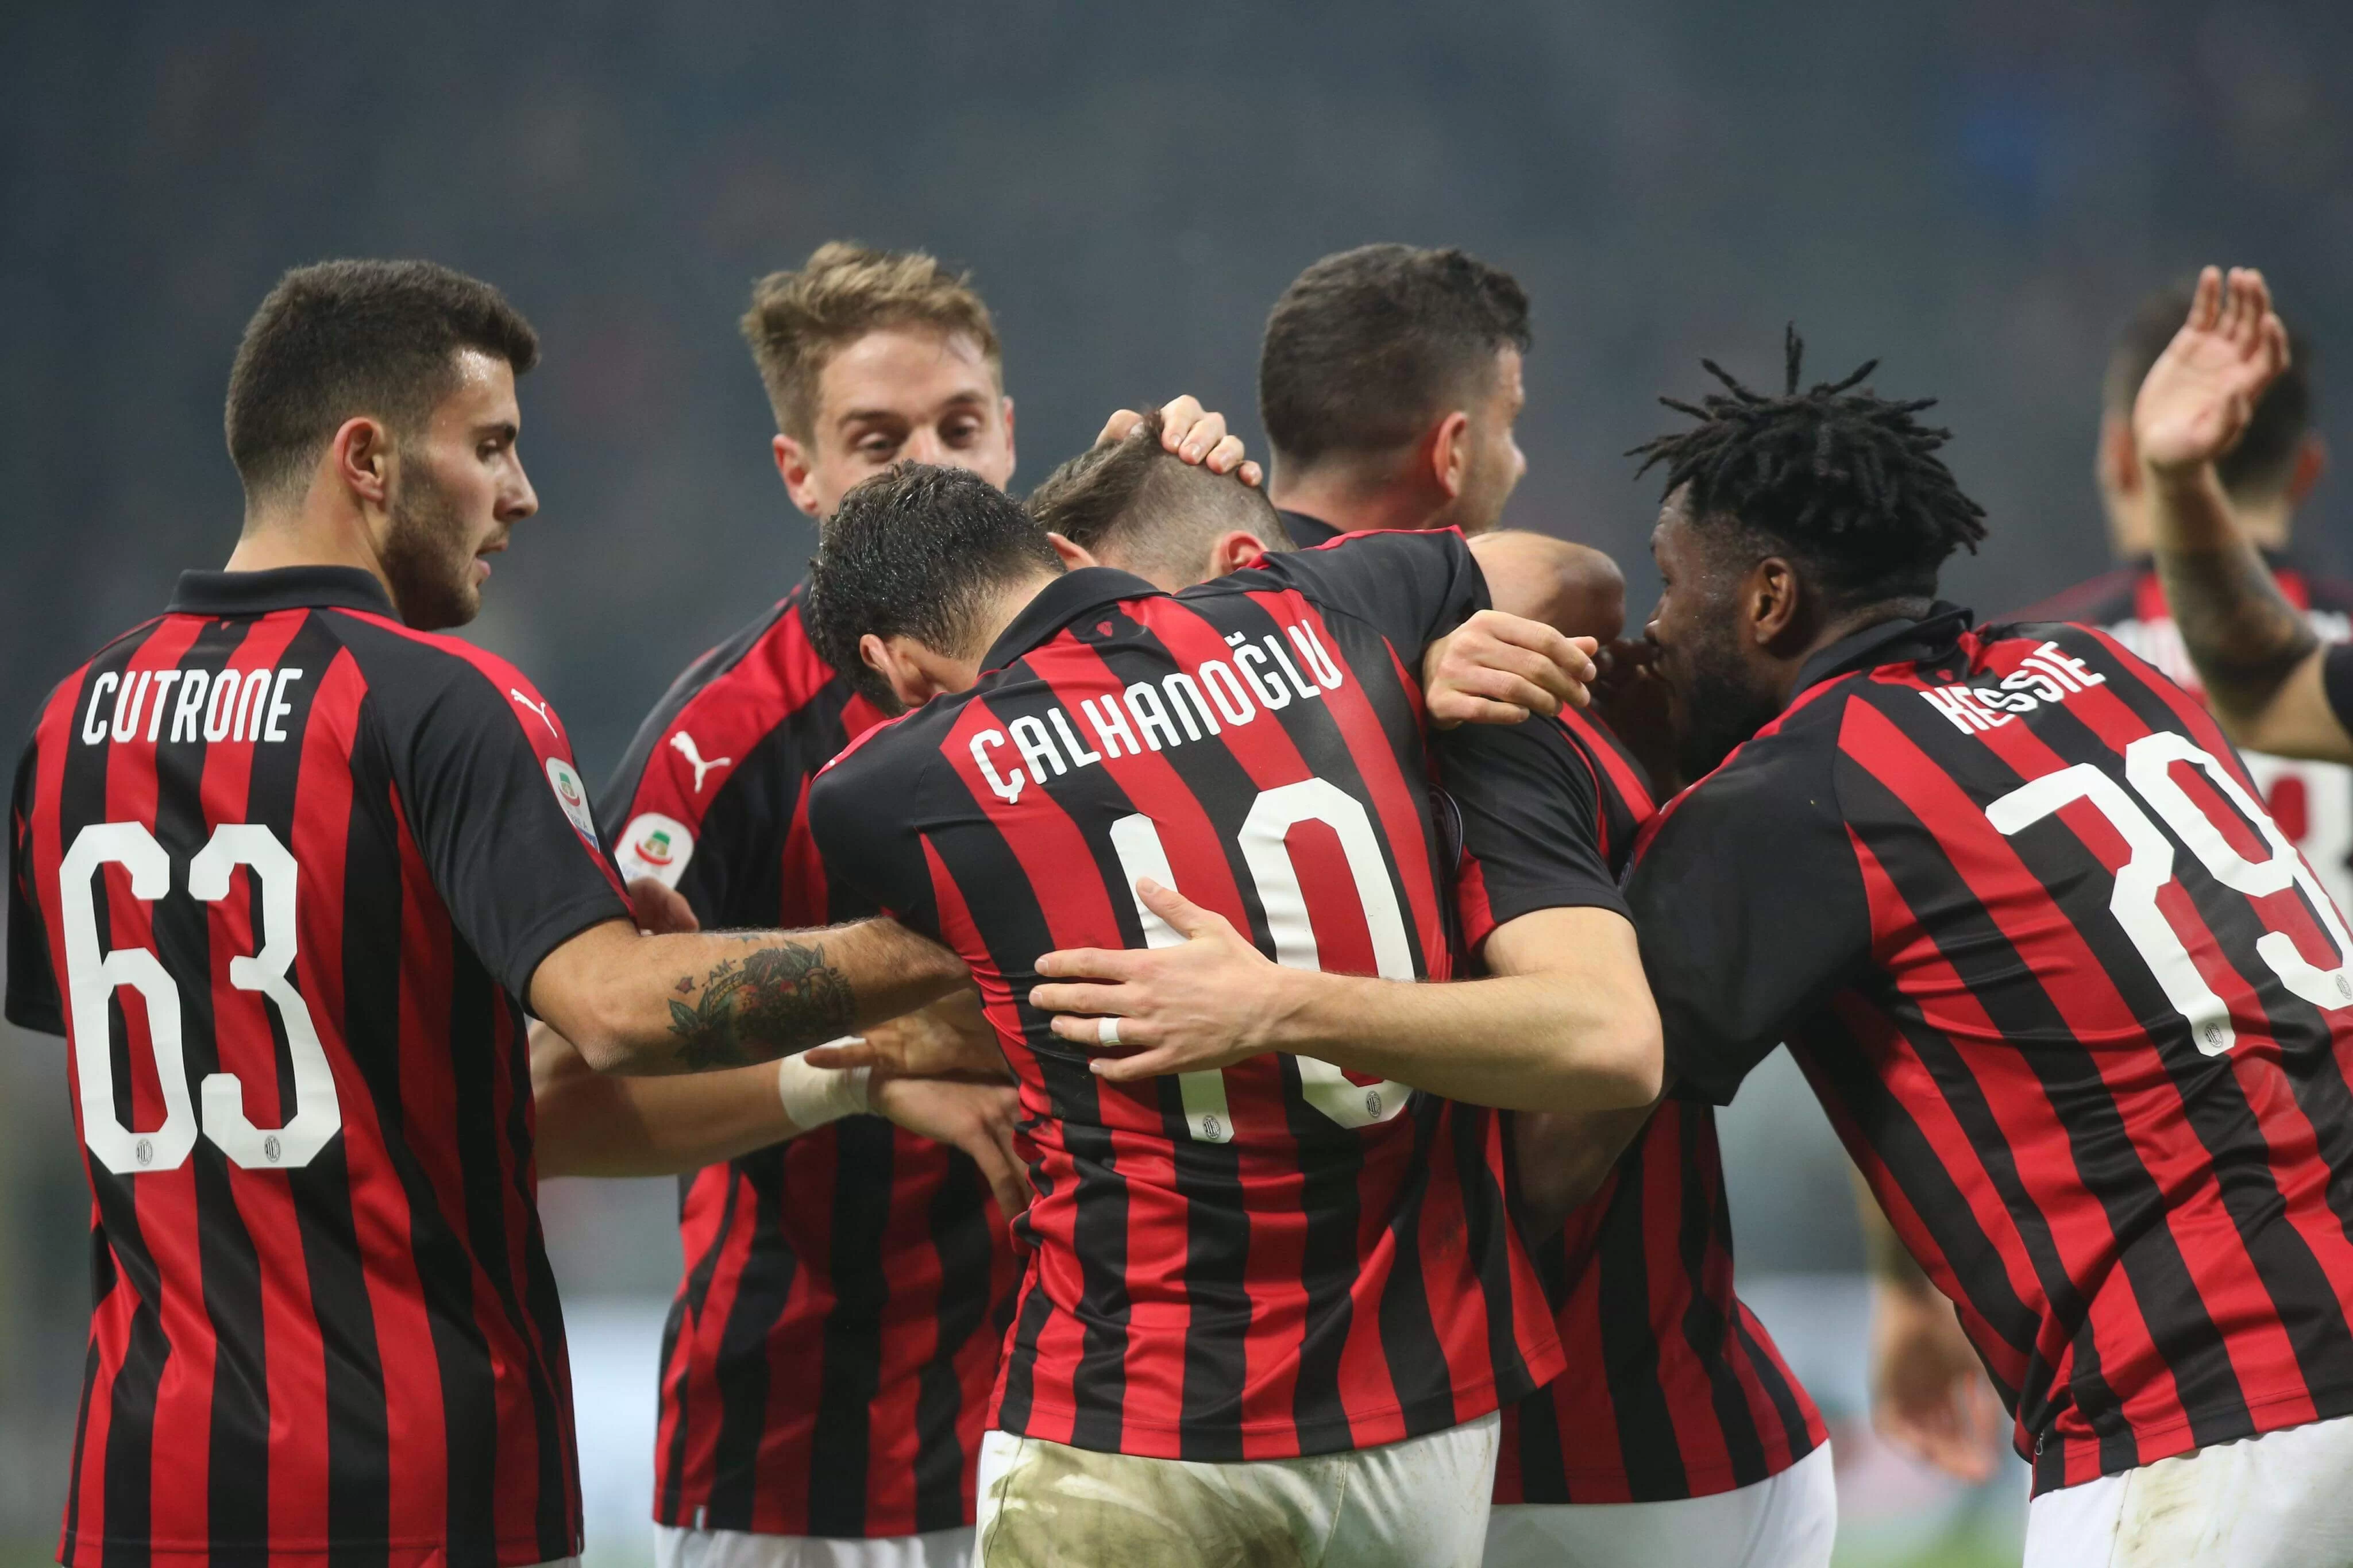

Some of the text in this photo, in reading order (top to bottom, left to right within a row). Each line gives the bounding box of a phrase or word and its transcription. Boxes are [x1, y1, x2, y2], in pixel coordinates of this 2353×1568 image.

[82, 668, 304, 745] CUTRONE
[969, 619, 1343, 804] ÇALHANOĞLU
[1919, 641, 2107, 735] KESSIE
[59, 821, 341, 1175] 63
[1109, 777, 1417, 1144] 10
[1985, 731, 2353, 1057] 79
